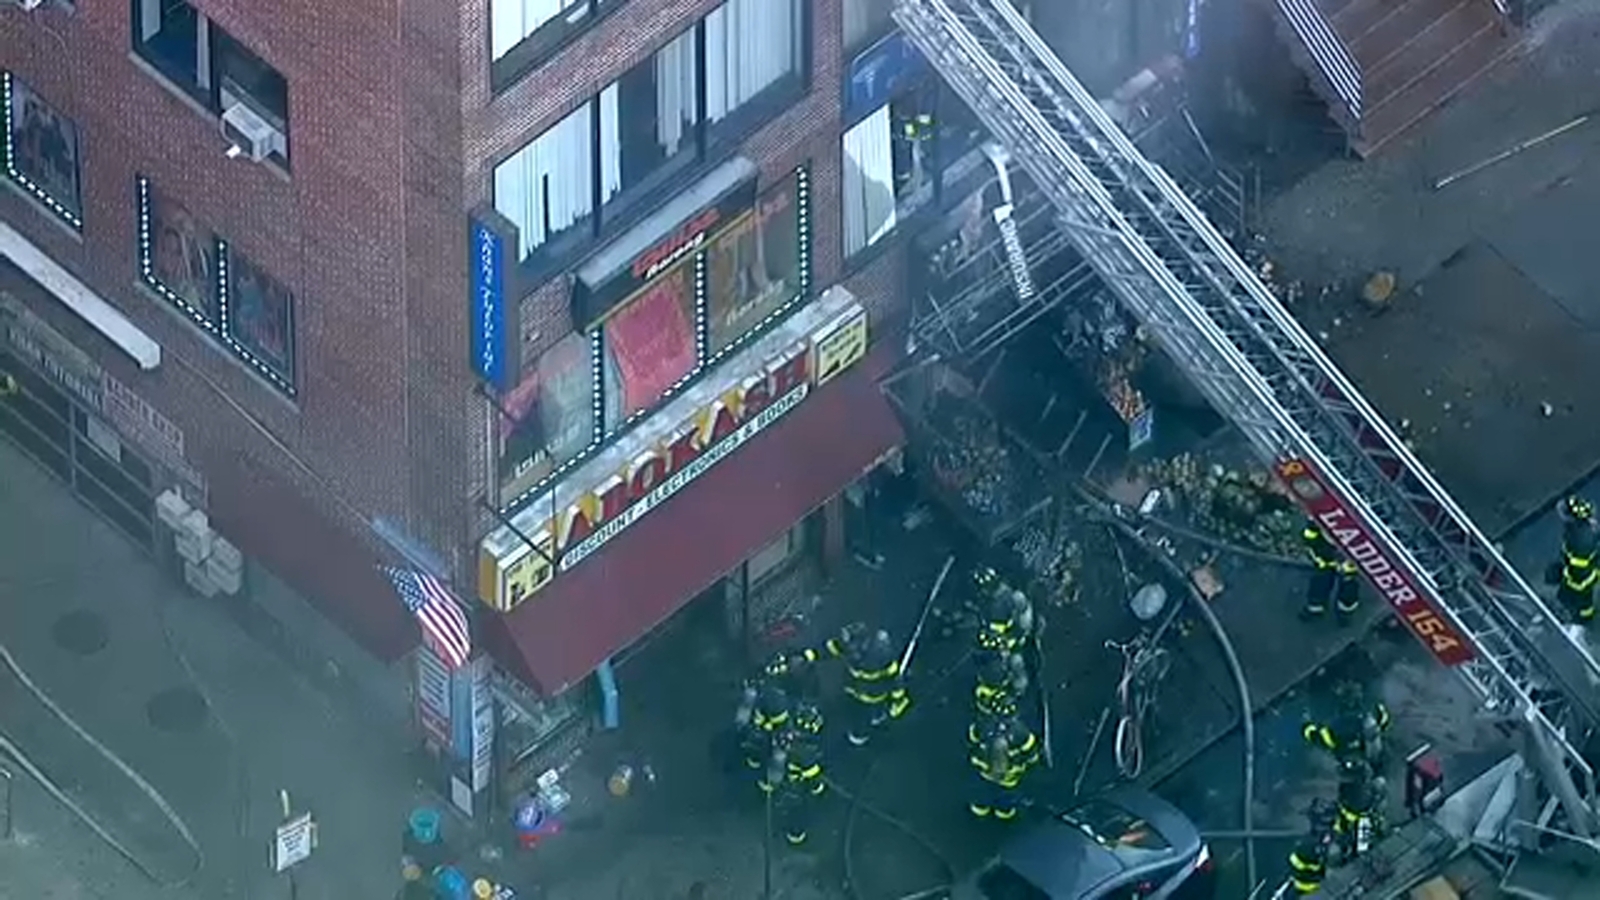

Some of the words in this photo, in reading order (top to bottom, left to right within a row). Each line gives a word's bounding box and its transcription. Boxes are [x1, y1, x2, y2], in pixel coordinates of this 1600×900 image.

[1000, 219, 1034, 299] INSURANC
[564, 507, 635, 566] DISCOUNT
[646, 433, 740, 508] ELECTRONICS
[757, 386, 804, 427] BOOKS
[1319, 507, 1417, 606] LADDER
[1407, 609, 1458, 653] 154
